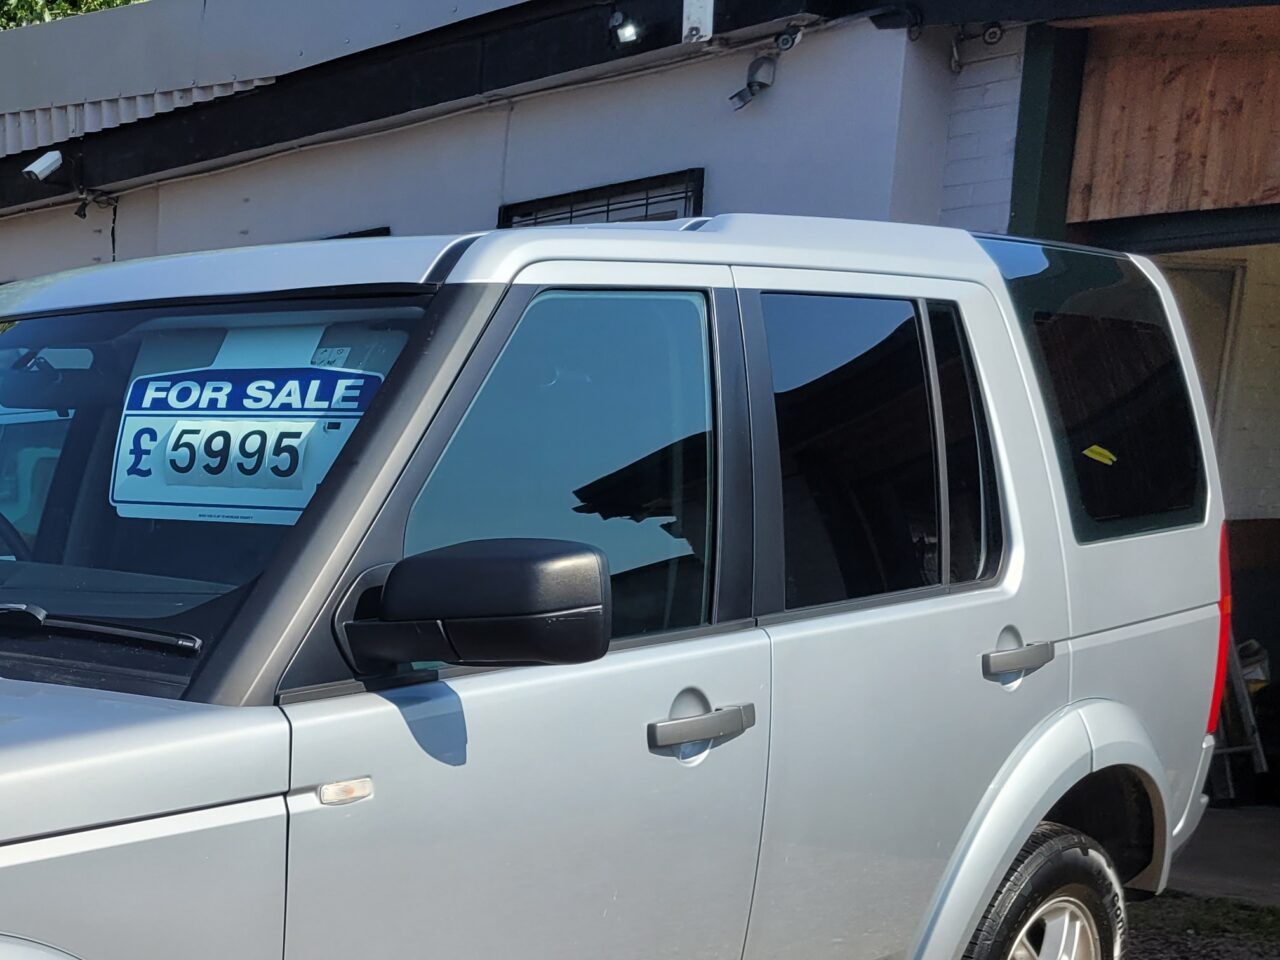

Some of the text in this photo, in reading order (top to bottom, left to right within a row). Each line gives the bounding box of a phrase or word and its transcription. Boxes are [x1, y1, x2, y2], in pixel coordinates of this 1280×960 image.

[141, 378, 365, 409] FOR SALE
[169, 428, 303, 478] 5995
